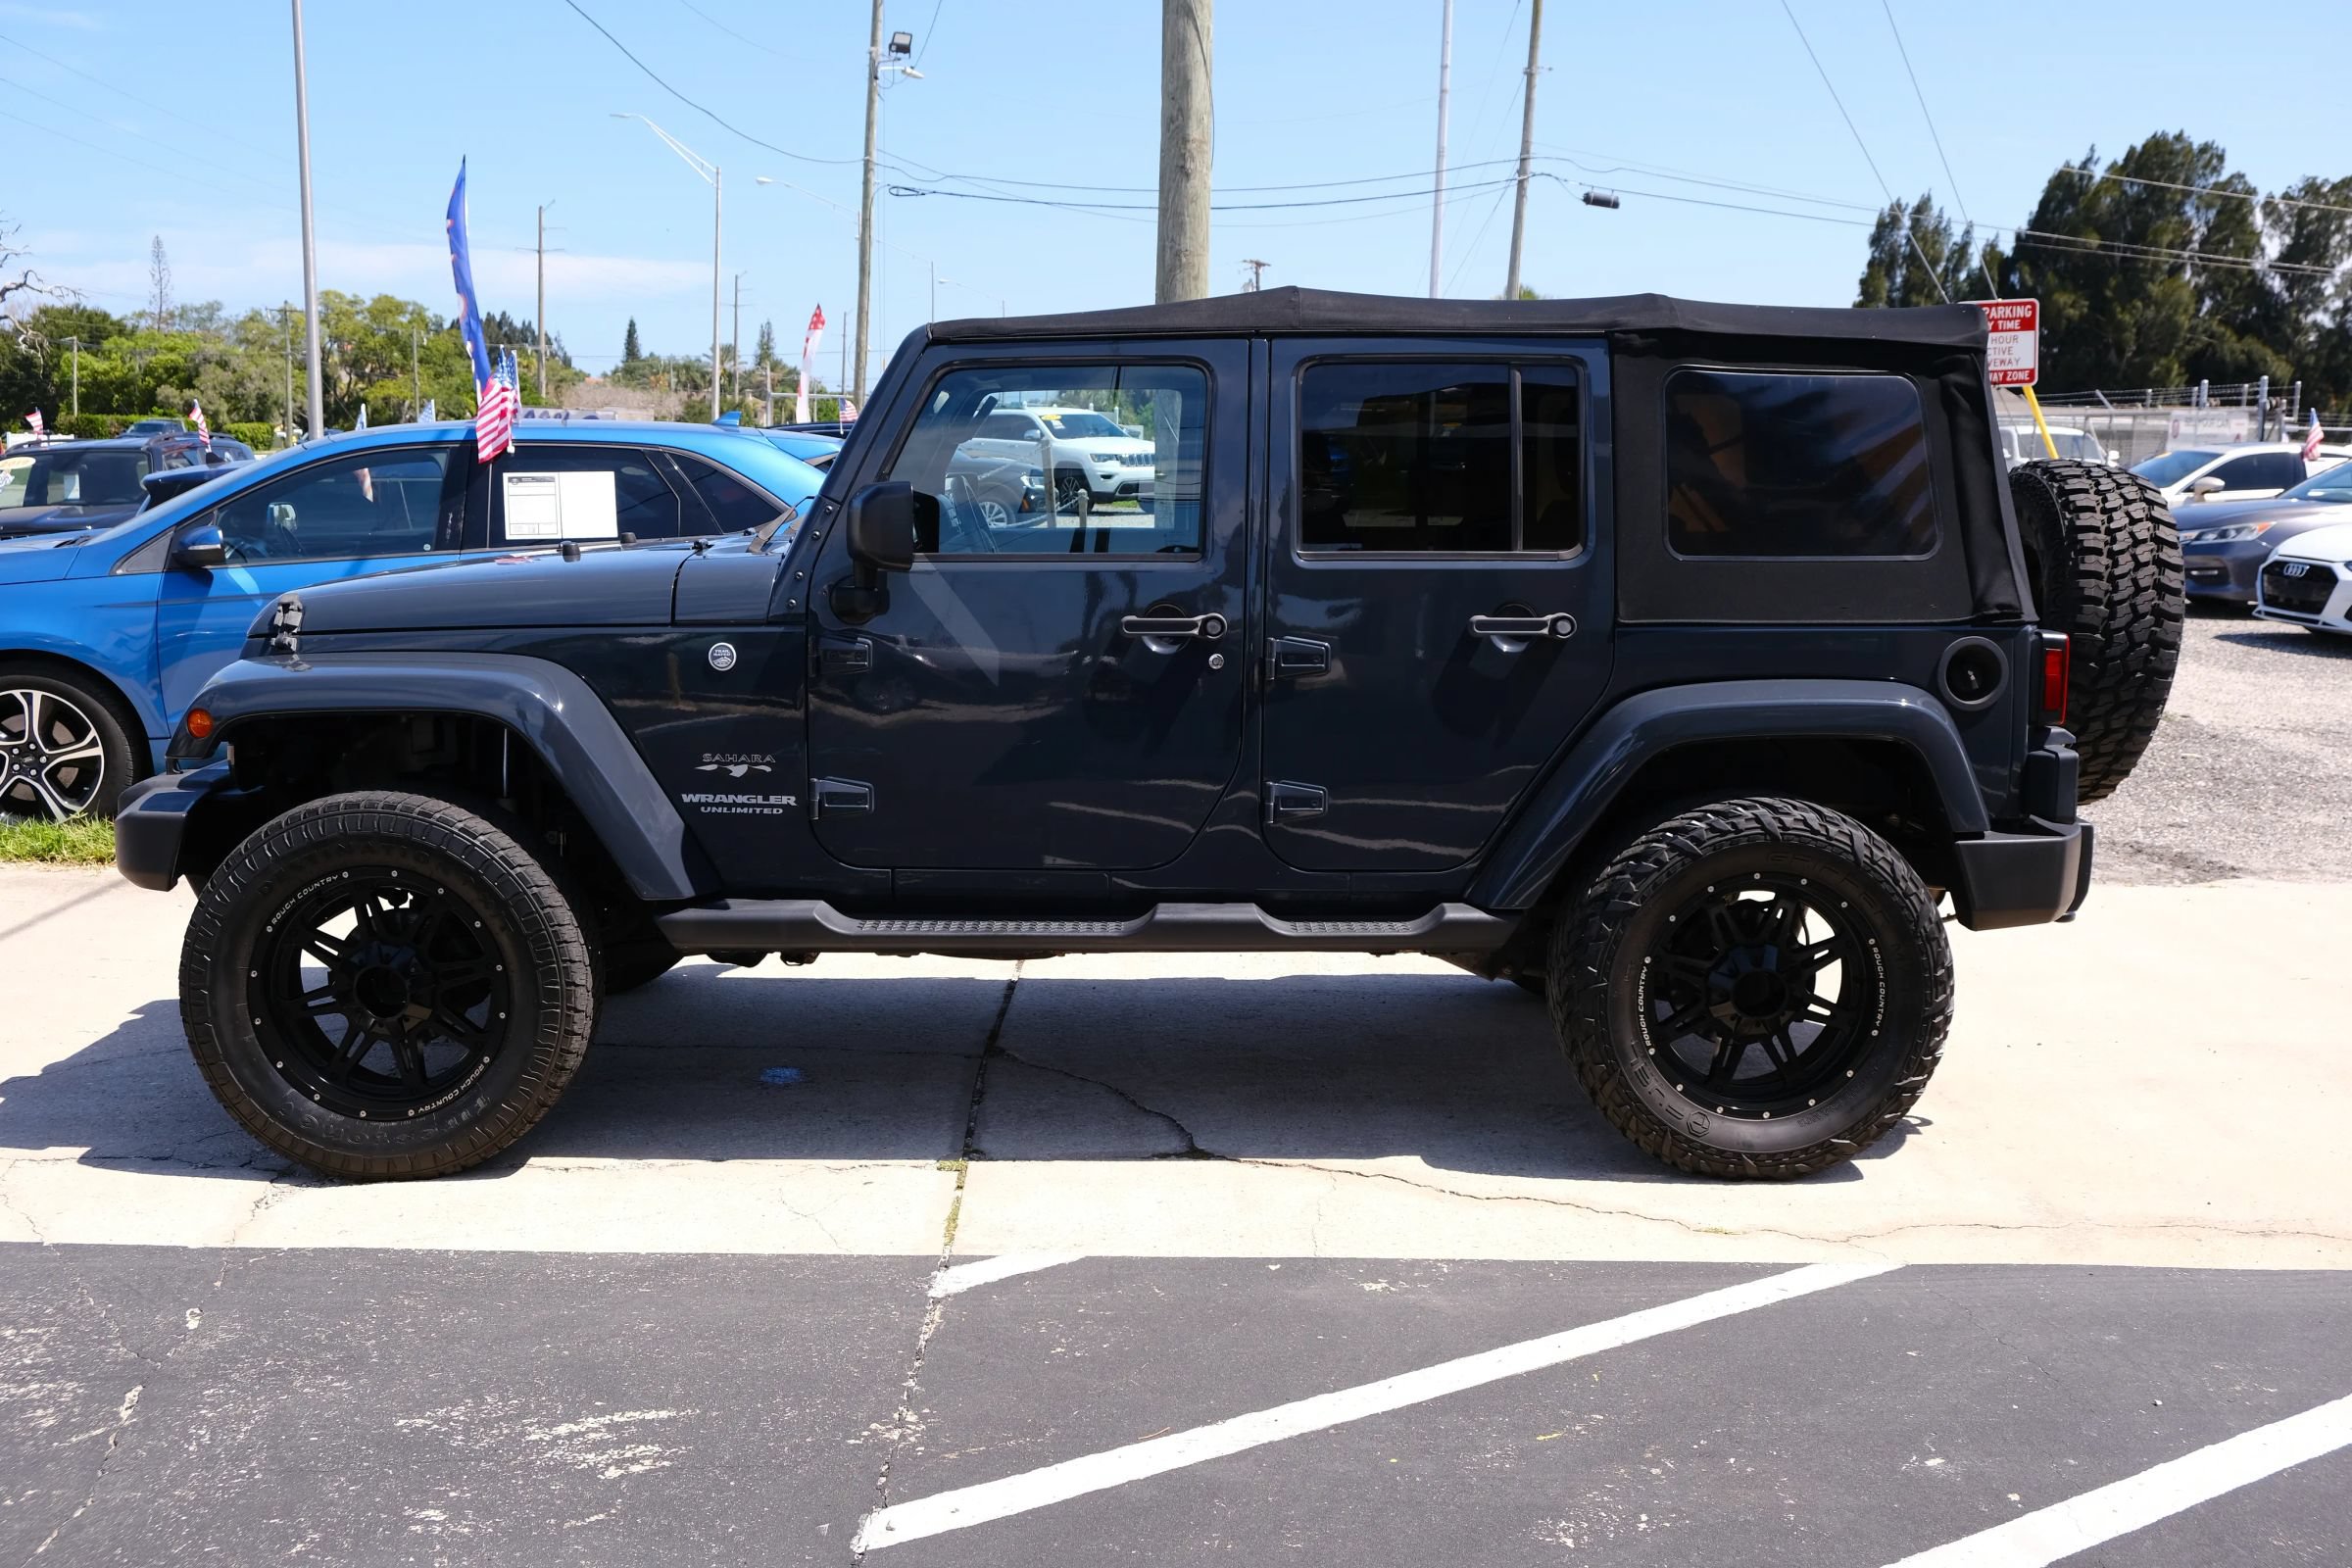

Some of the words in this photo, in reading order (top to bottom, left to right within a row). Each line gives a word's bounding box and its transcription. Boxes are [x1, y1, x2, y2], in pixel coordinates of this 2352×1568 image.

[1998, 319, 2021, 330] TIME
[1991, 335, 2019, 345] HOUR
[2006, 369, 2031, 381] ZONE
[702, 753, 776, 763] SAHARA
[681, 793, 797, 807] WRANGLER
[700, 806, 784, 814] UNLIMITED
[270, 898, 296, 925] ROUGH
[296, 874, 338, 900] COUNTRY
[1872, 947, 1885, 979] ROUGH
[1638, 965, 1648, 1012] COUNTRY
[1875, 981, 1886, 1027] COUNTRY
[1639, 1014, 1652, 1047] ROUGH
[460, 1063, 485, 1091] ROUGH
[417, 1089, 460, 1114] COUNTRY
